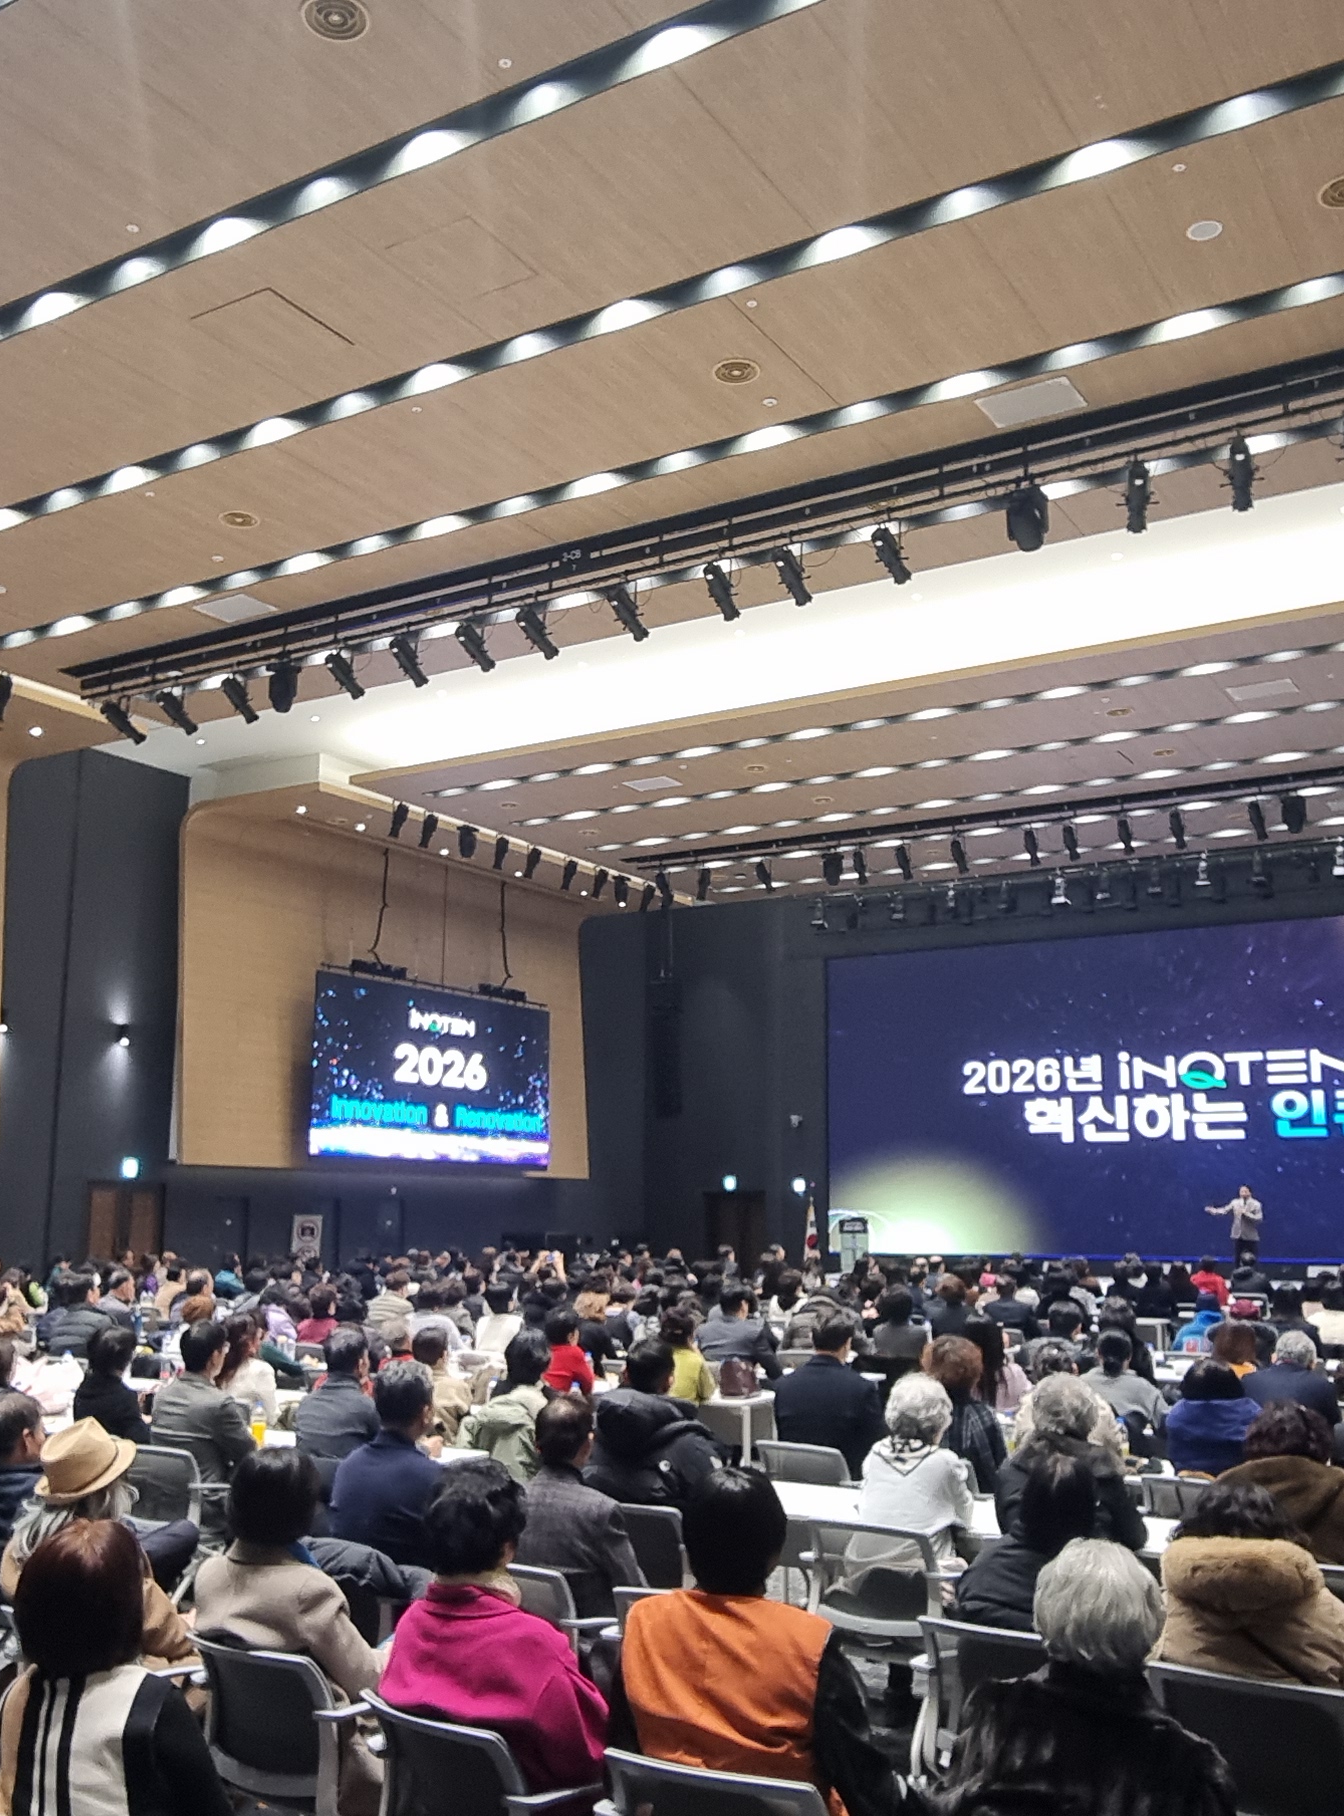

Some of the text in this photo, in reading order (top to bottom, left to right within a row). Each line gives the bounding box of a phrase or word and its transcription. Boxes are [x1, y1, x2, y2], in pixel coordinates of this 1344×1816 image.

[393, 1043, 488, 1091] 2026
[962, 1053, 1103, 1097] 2026년
[331, 1094, 543, 1132] Innovation & Renovation
[1023, 1095, 1248, 1144] 혁신하는
